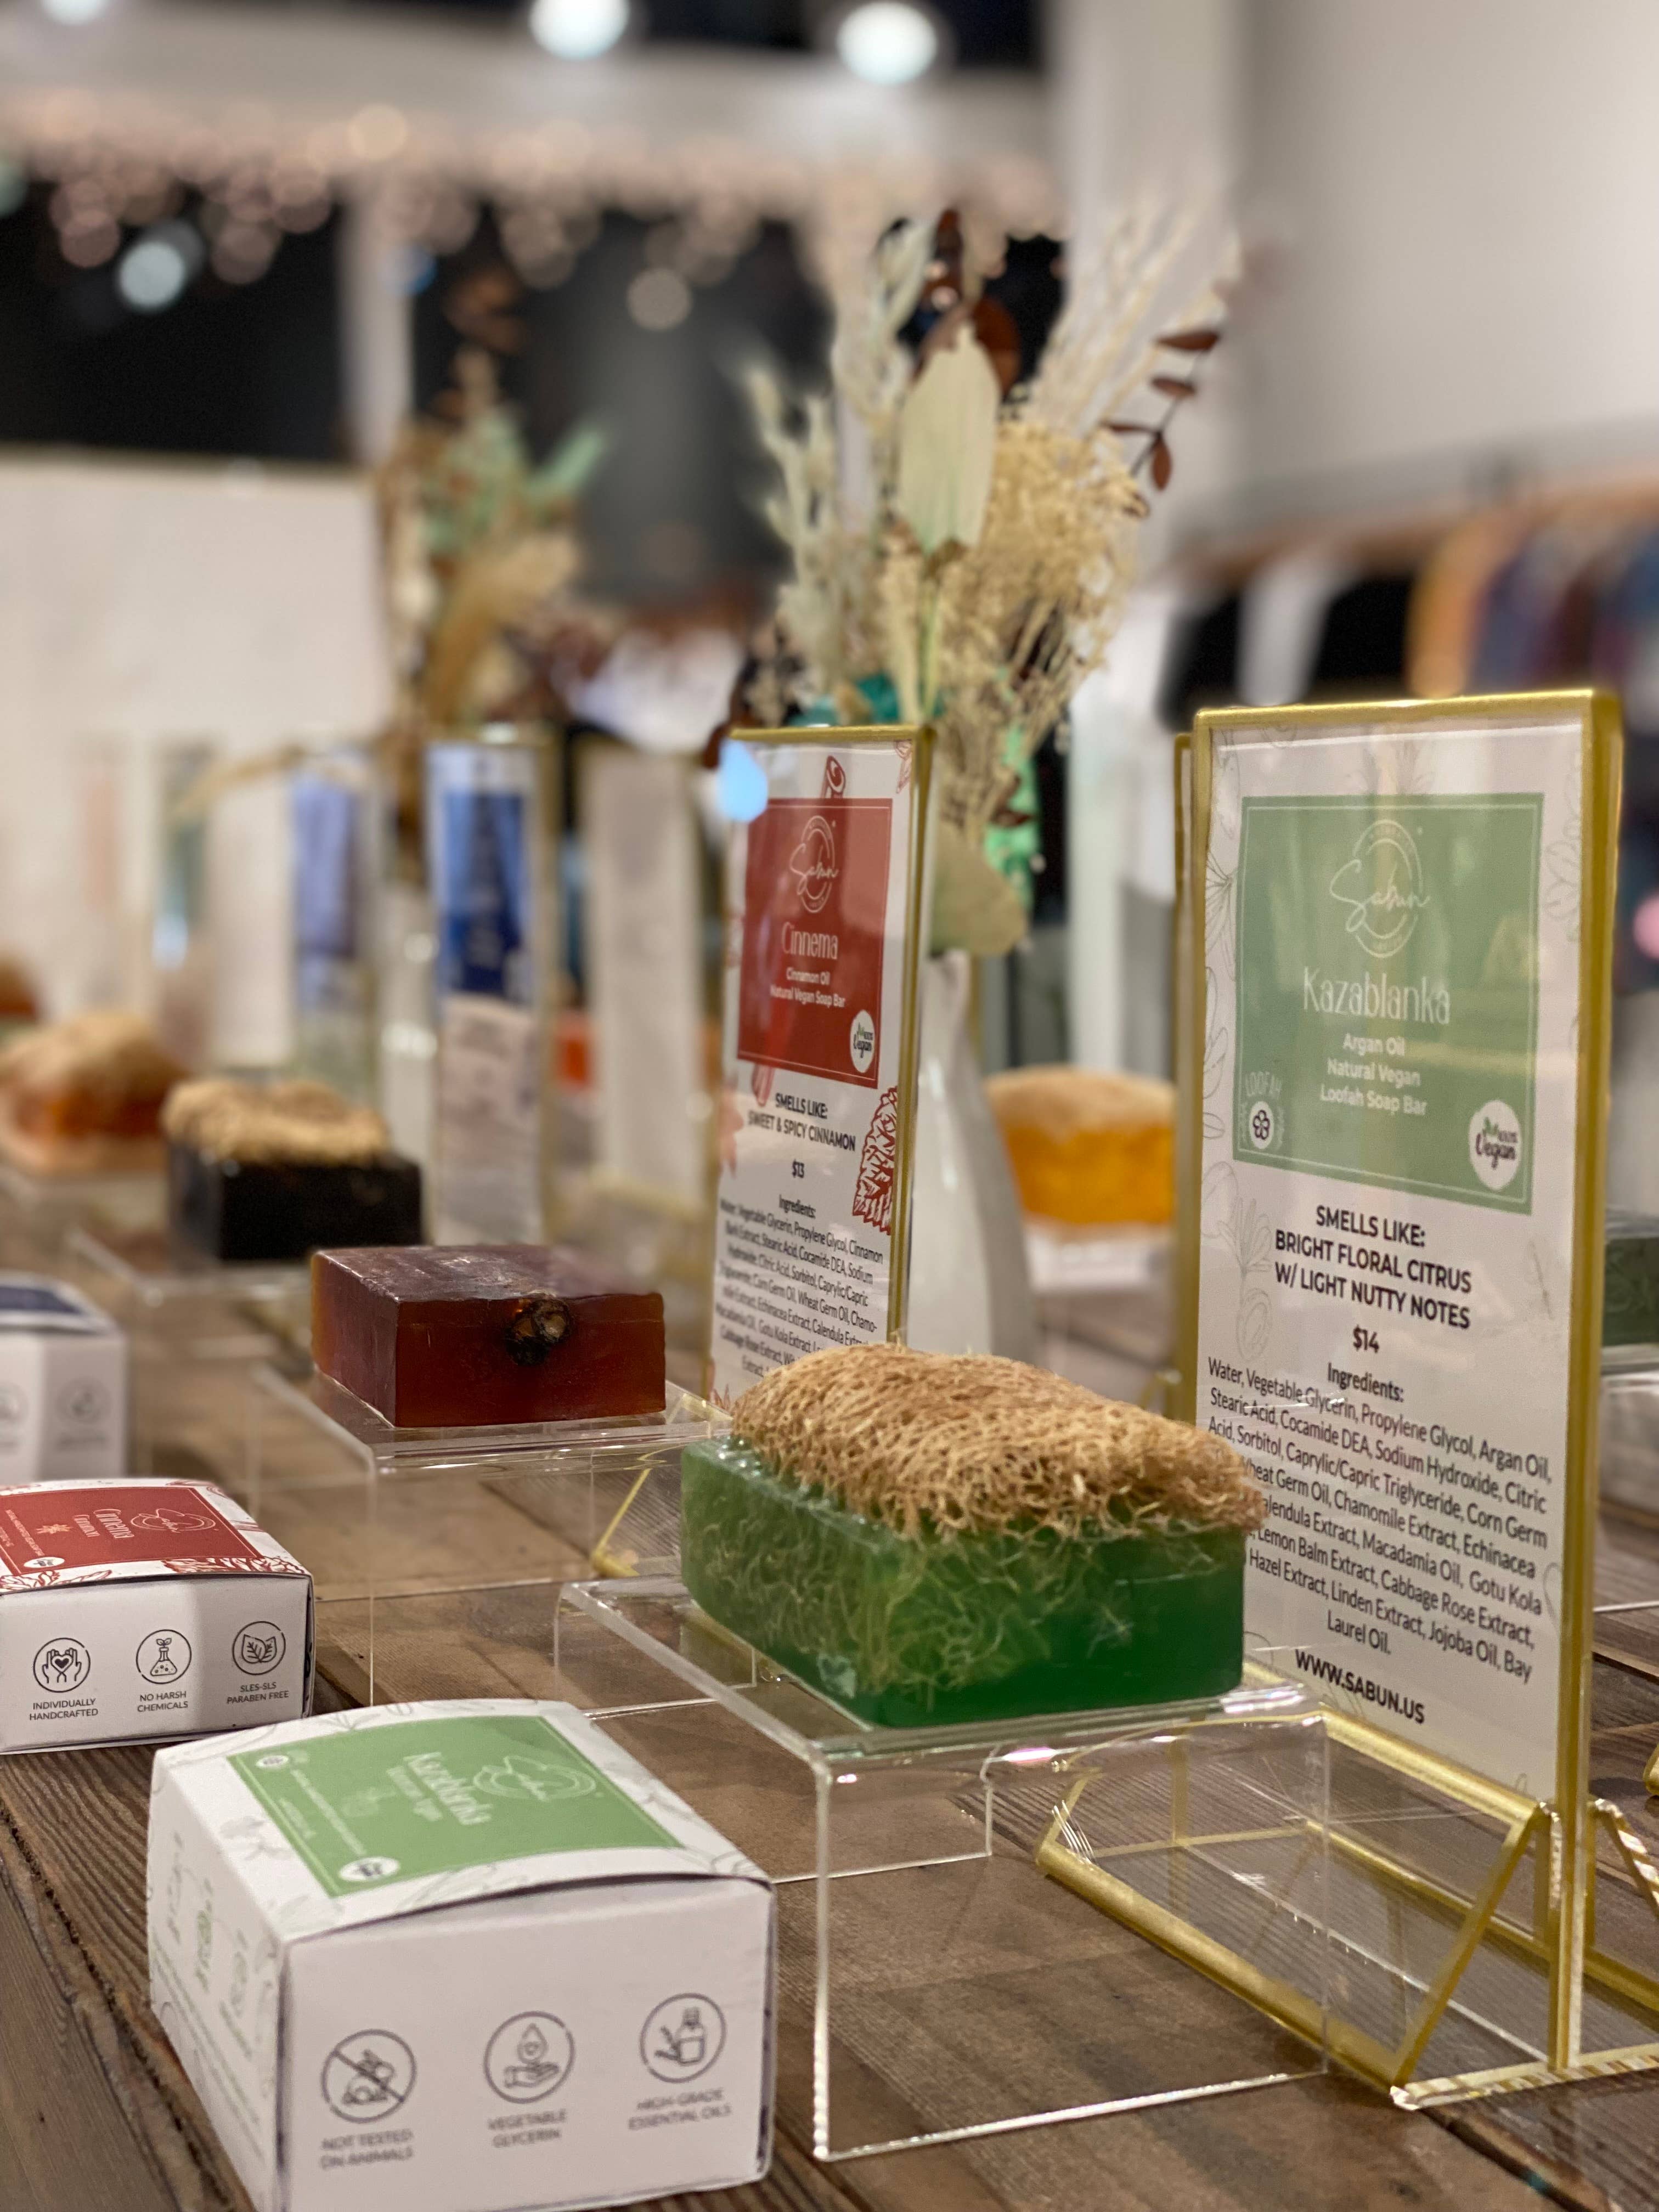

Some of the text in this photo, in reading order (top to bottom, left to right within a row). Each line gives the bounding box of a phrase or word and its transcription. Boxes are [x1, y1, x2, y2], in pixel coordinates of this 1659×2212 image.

[781, 921, 839, 960] Cinnema
[785, 966, 831, 986] Cinnamon Oil
[770, 984, 846, 1008] Natural Vegan Soap Bar
[1304, 966, 1450, 1025] Kazablanka
[1342, 1032, 1406, 1057] Argan Oil
[1327, 1057, 1421, 1088] Natural Vegan
[775, 1092, 828, 1120] SMELLS LIKE:
[1319, 1084, 1427, 1116] Loofah Soap Bar
[748, 1109, 856, 1152] SWEET & SPICY CINNAMON
[1475, 1132, 1516, 1169] Vegan
[792, 1158, 805, 1179] $13
[778, 1193, 816, 1219] Ingredients:
[1316, 1205, 1426, 1248] SMELLS LIKE:
[761, 1231, 783, 1251] Stearic
[799, 1245, 831, 1270] Cocamide
[848, 1261, 874, 1285] Sodium
[794, 1221, 826, 1245] Propylene
[848, 1238, 884, 1265] Cinnamon
[1275, 1229, 1472, 1294] BRIGHT FLORAL CITRUS
[768, 1279, 786, 1296] Germ
[798, 1289, 820, 1312] Wheat
[819, 1298, 838, 1319] Germ
[850, 1310, 878, 1333] Chamo-
[1274, 1261, 1471, 1330] W/ LIGHT NUTTY NOTES
[758, 1296, 788, 1321] Echinacea
[788, 1308, 812, 1332] Extract,
[812, 1318, 844, 1345] Calendula
[788, 1330, 812, 1353] Extract,
[1352, 1324, 1380, 1353] $14
[1328, 1362, 1404, 1403] Ingredients:
[1208, 1356, 1552, 1485] Water, Vegetable Glycerin, Propylene Glycol, Argan Oil,
[1210, 1386, 1547, 1515] Stearic Acid, Cocamide DEA, Sodium Hydroxide, Citric
[1208, 1415, 1548, 1550] Acid, Sorbitol, Caprylic/Capric Triglyceride, Corn Germ
[93, 1508, 135, 1539] Cinnema
[1276, 1468, 1309, 1497] Germ
[1311, 1480, 1332, 1508] Oil,
[1334, 1489, 1406, 1532] Chamomile
[1408, 1514, 1460, 1554] Extract,
[1463, 1534, 1536, 1579] Echinacea
[1262, 1494, 1542, 1616] alendula Extract, Macadamia Oil, Gotu Kola
[1258, 1525, 1536, 1651] Lemon Balm Extract, Cabbage Rose Extract,
[1250, 1547, 1533, 1685] Hazel Extract, Linden Extract, Jojoba Oil, Bay
[1328, 1609, 1392, 1655] Laurel Oil.
[139, 1690, 187, 1702] NO HARSH
[226, 1690, 290, 1705] PARABEN FREE
[240, 1681, 277, 1692] SLES-SLS
[1294, 1648, 1425, 1724] WWW.SABUN.US
[29, 1708, 99, 1722] HANDCRAFTED
[32, 1697, 97, 1711] INDIVIDUALLY
[137, 1701, 189, 1713] CHEMICALS
[487, 2108, 568, 2131] VEGETABLE
[628, 2102, 733, 2131] ESSENTIAL OILS
[321, 2128, 415, 2151] NOT TESTED
[492, 2128, 563, 2149] GLYCERIN
[319, 2146, 415, 2172] ON ANIMALS
